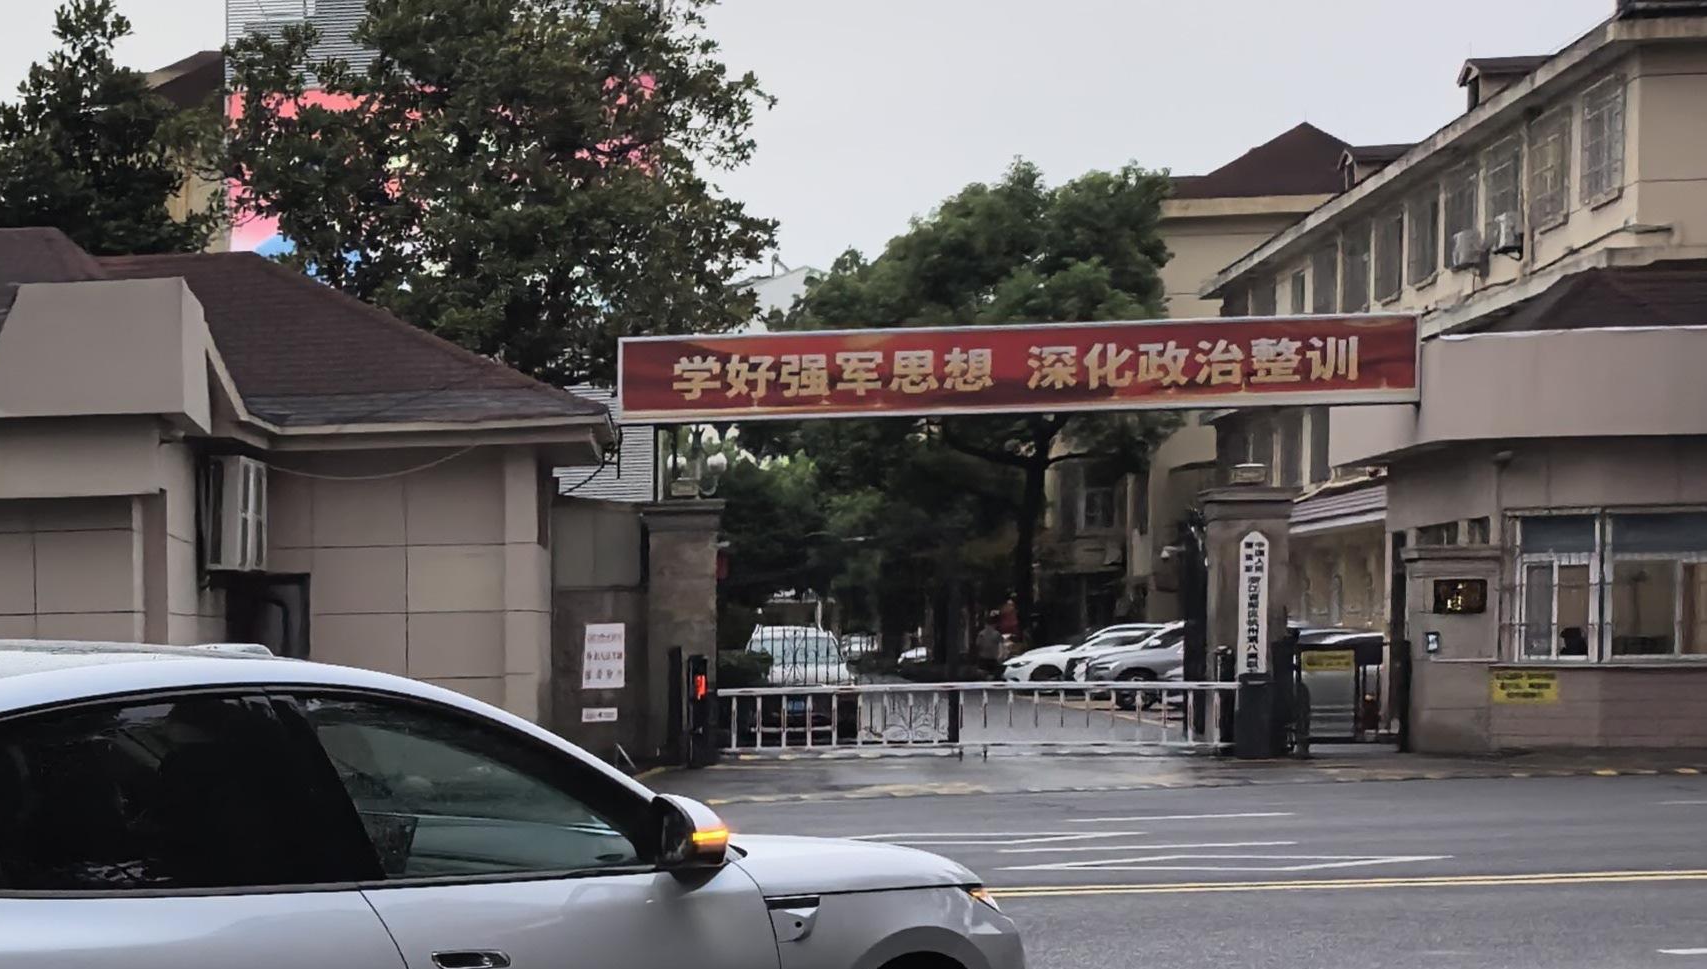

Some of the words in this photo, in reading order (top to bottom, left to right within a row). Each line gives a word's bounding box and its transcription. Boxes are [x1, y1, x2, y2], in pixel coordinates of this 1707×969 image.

[673, 348, 994, 400] 学好强军思想
[1028, 336, 1360, 390] 深化政治整训
